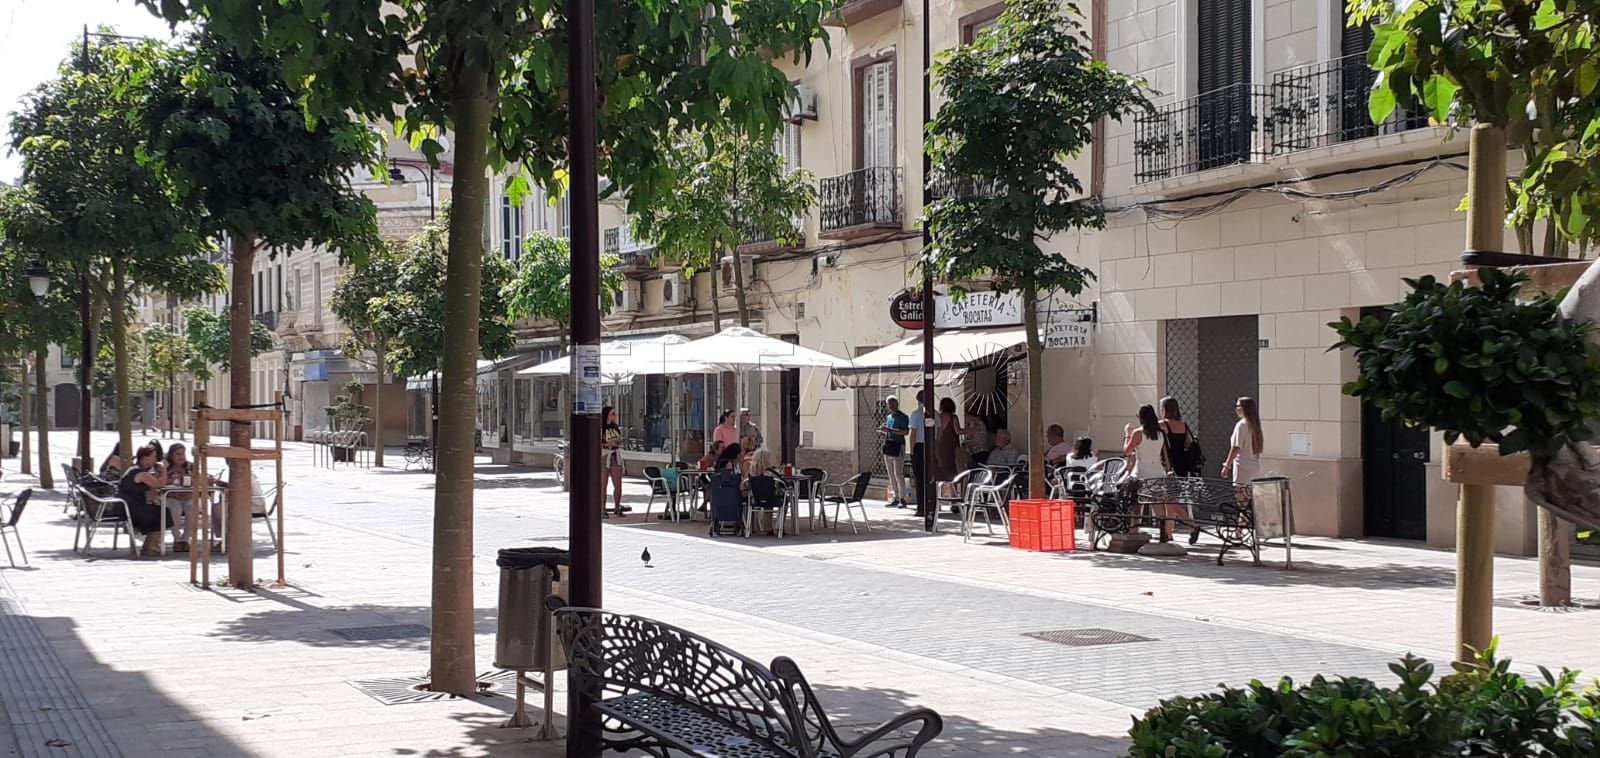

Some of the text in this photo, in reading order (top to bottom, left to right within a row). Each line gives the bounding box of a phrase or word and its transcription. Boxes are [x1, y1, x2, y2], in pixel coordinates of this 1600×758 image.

[898, 300, 924, 310] Estrel
[951, 294, 1005, 317] CAFETERIA
[900, 310, 924, 320] Galic
